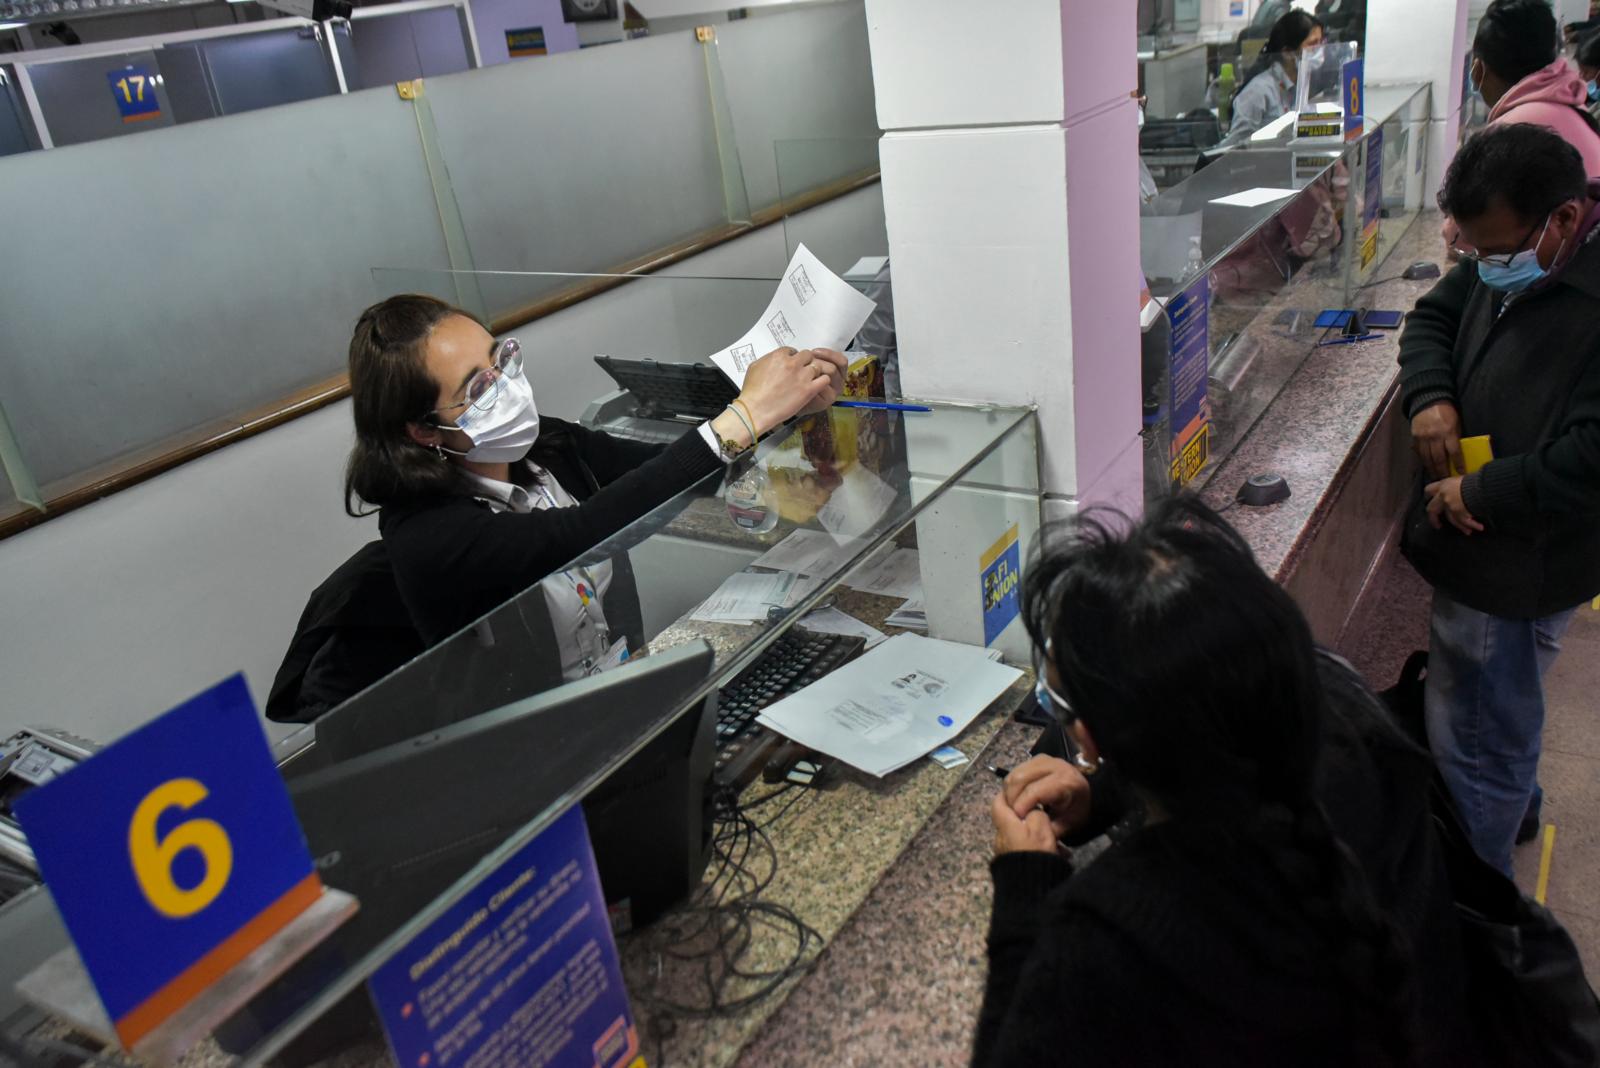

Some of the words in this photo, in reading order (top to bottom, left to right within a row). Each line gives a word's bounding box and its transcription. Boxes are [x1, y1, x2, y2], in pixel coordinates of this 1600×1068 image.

[117, 75, 145, 103] 17
[1350, 76, 1359, 115] 8
[128, 777, 233, 918] 6
